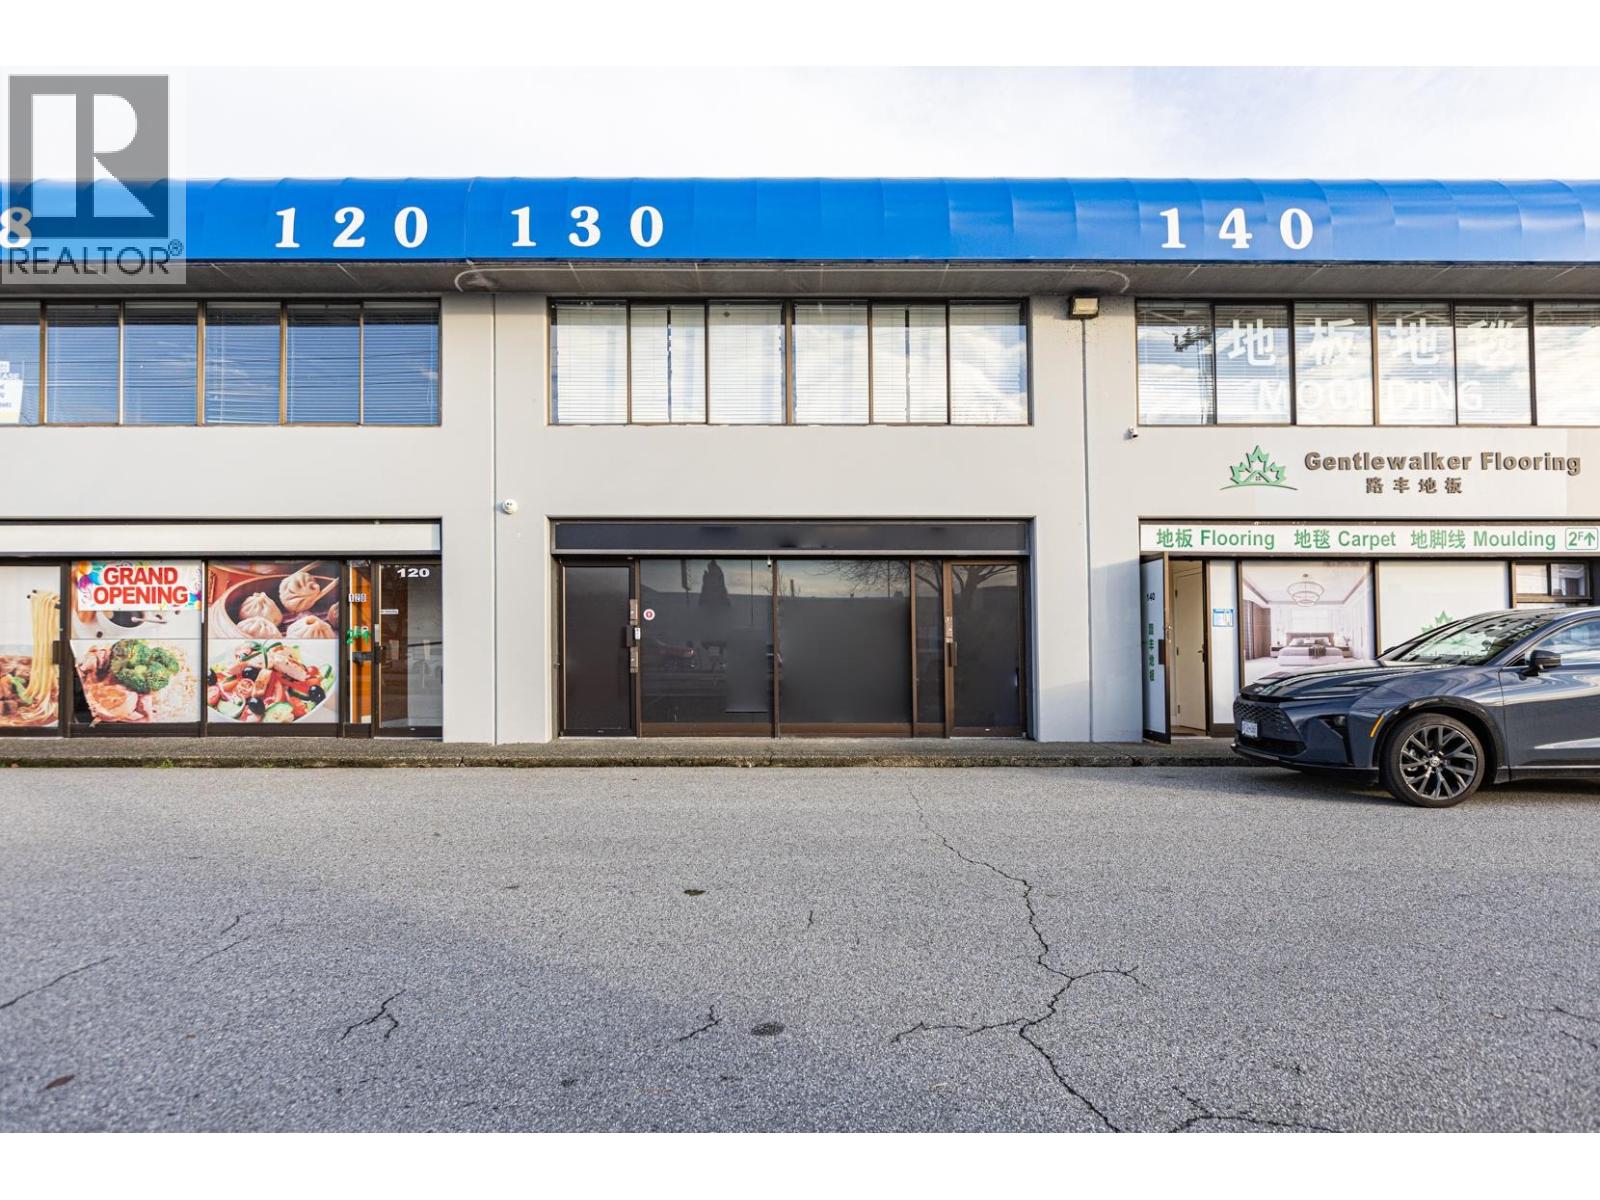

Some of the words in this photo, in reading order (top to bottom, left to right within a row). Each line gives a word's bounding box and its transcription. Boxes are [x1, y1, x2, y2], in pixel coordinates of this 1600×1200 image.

[275, 206, 429, 249] 120
[511, 205, 664, 248] 130
[1159, 207, 1314, 250] 140
[1304, 451, 1473, 471] Gentlewalker
[1480, 451, 1582, 476] Flooring
[1365, 477, 1464, 494] 路丰地板
[1156, 528, 1193, 548] 地板
[1200, 529, 1275, 550] Flooring
[1294, 528, 1331, 549] 地毯
[1338, 530, 1396, 550] Carpet
[1411, 529, 1466, 550] 地脚线
[1473, 530, 1556, 550] Moulding
[103, 567, 179, 585] GRAND
[397, 568, 430, 578] 120
[93, 585, 189, 605] OPENING
